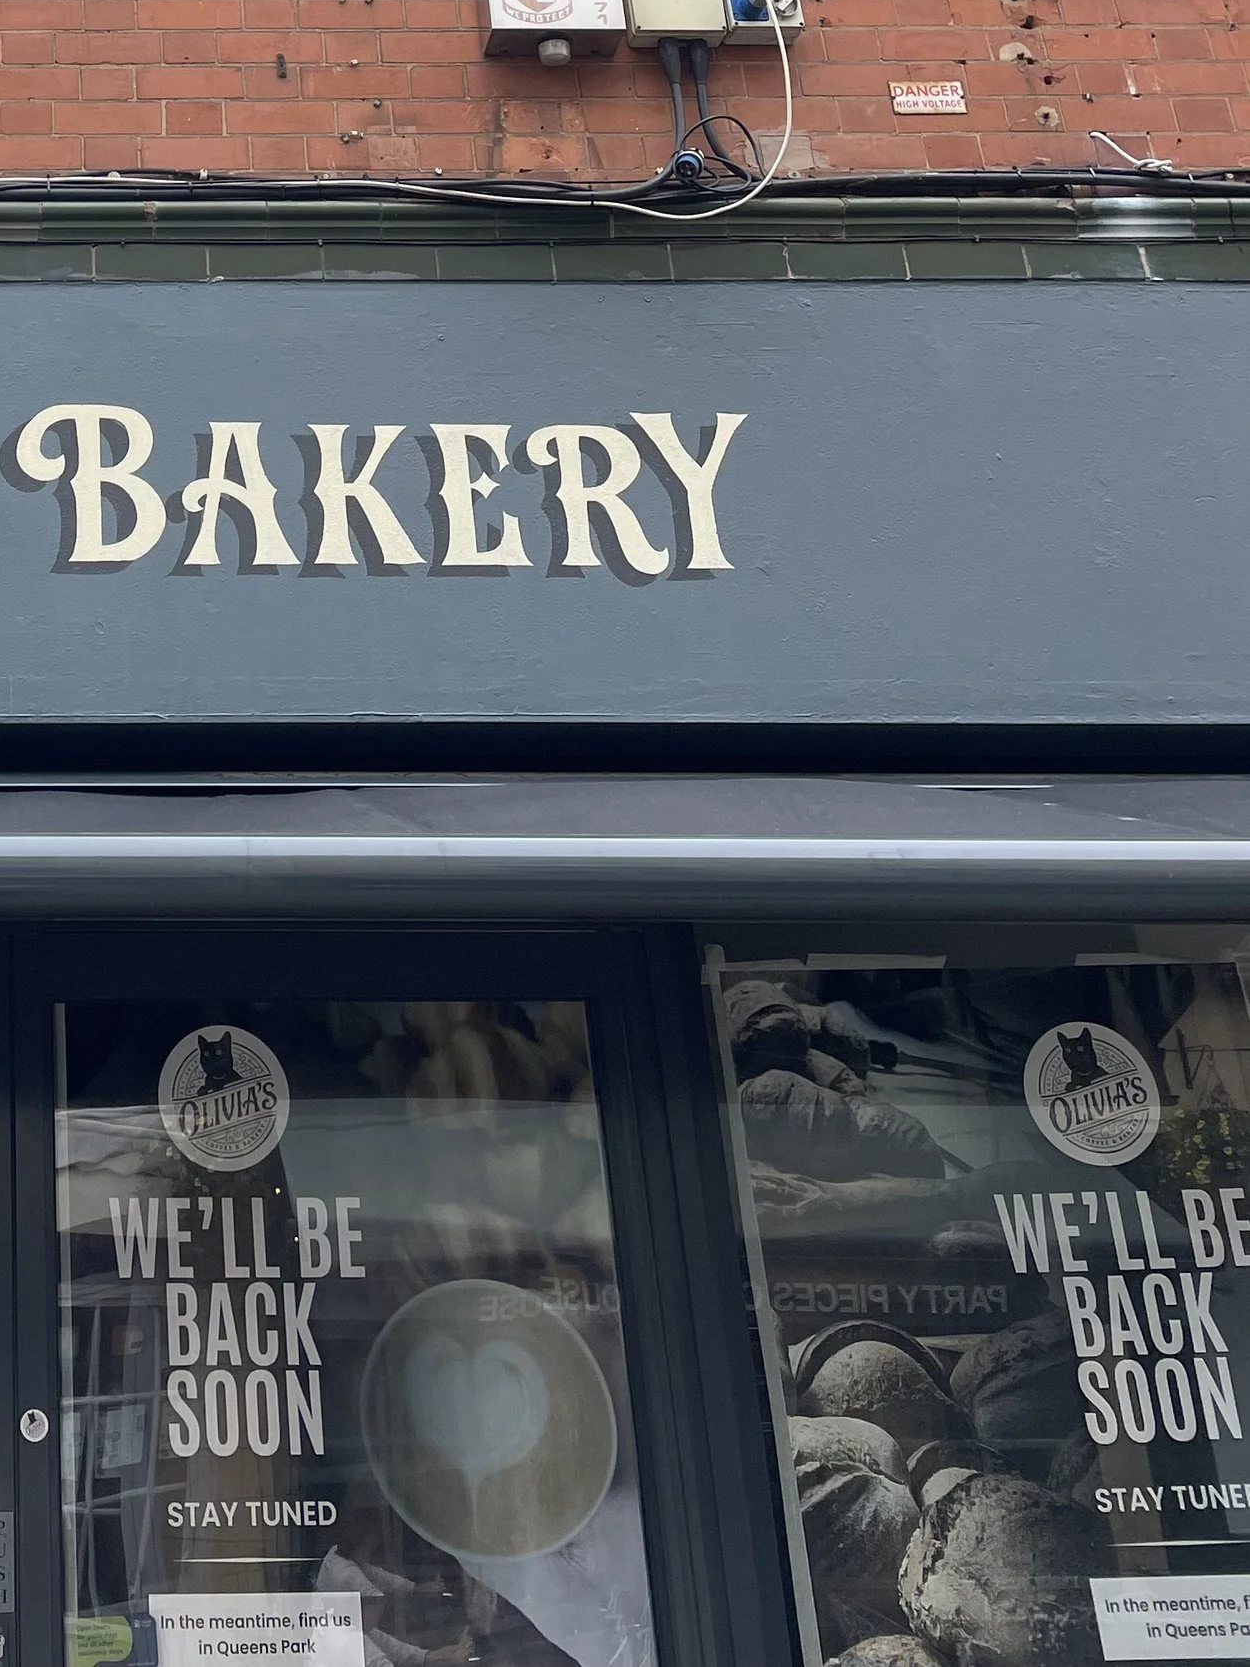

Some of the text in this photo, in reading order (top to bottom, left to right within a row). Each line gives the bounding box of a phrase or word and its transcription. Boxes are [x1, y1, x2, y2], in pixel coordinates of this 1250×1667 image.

[523, 7, 571, 23] PROTECT
[893, 85, 961, 97] DANGER
[896, 99, 962, 108] HIGH VOLTAGE
[18, 402, 749, 575] BAKERY
[179, 1082, 278, 1136] OLIVIA'S
[1050, 1076, 1148, 1133] OLIVIA'S
[108, 1196, 366, 1279] WE'LL BE
[993, 1187, 1250, 1274] WE'LL BE
[166, 1281, 322, 1367] BACK
[1062, 1272, 1229, 1358] BACK
[166, 1368, 325, 1457] SOON
[1078, 1356, 1243, 1445] SOON
[167, 1501, 337, 1528] STAY TUNED
[1094, 1486, 1164, 1513] STAY
[160, 1615, 174, 1629] In
[179, 1615, 205, 1629] the
[209, 1613, 295, 1630] meantime,
[298, 1612, 328, 1627] find
[332, 1615, 351, 1627] us
[1105, 1599, 1120, 1613] In
[1123, 1598, 1149, 1612] the
[1153, 1595, 1241, 1613] meantime,
[199, 1639, 316, 1657] in Queens Park
[1146, 1622, 1161, 1638] in
[1165, 1623, 1226, 1640] Queens
